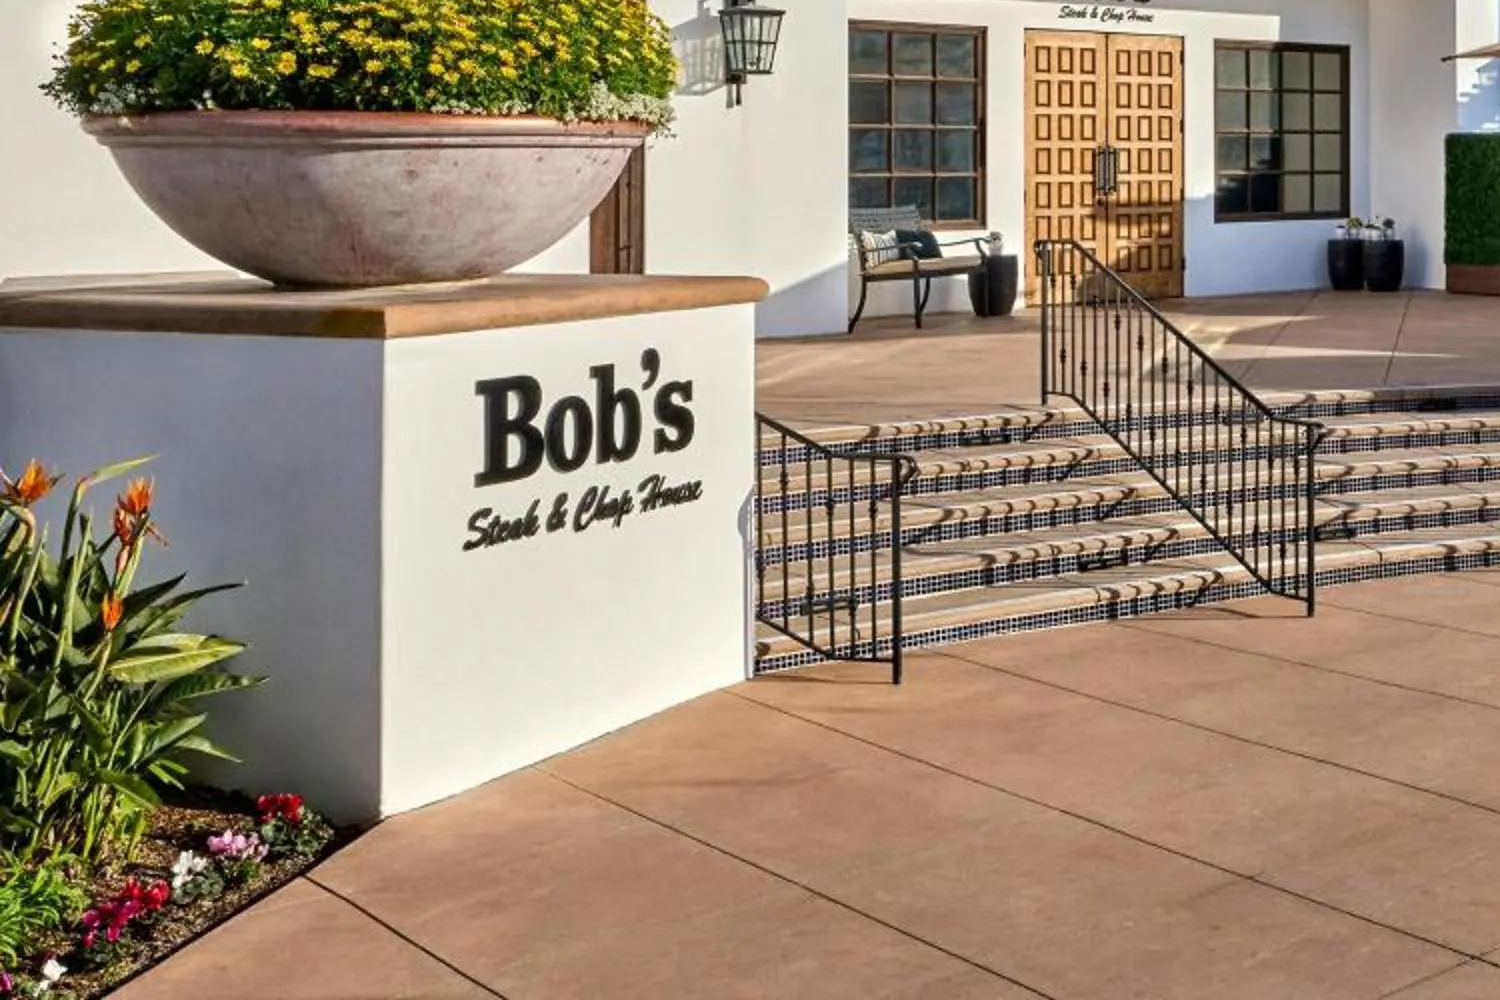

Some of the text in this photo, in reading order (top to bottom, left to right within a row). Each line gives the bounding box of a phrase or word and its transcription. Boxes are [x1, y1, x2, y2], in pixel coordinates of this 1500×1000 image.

[1057, 5, 1088, 19] Steak
[1089, 6, 1099, 19] &
[473, 347, 696, 488] Bob's
[462, 473, 703, 551] Steak & Chop House
